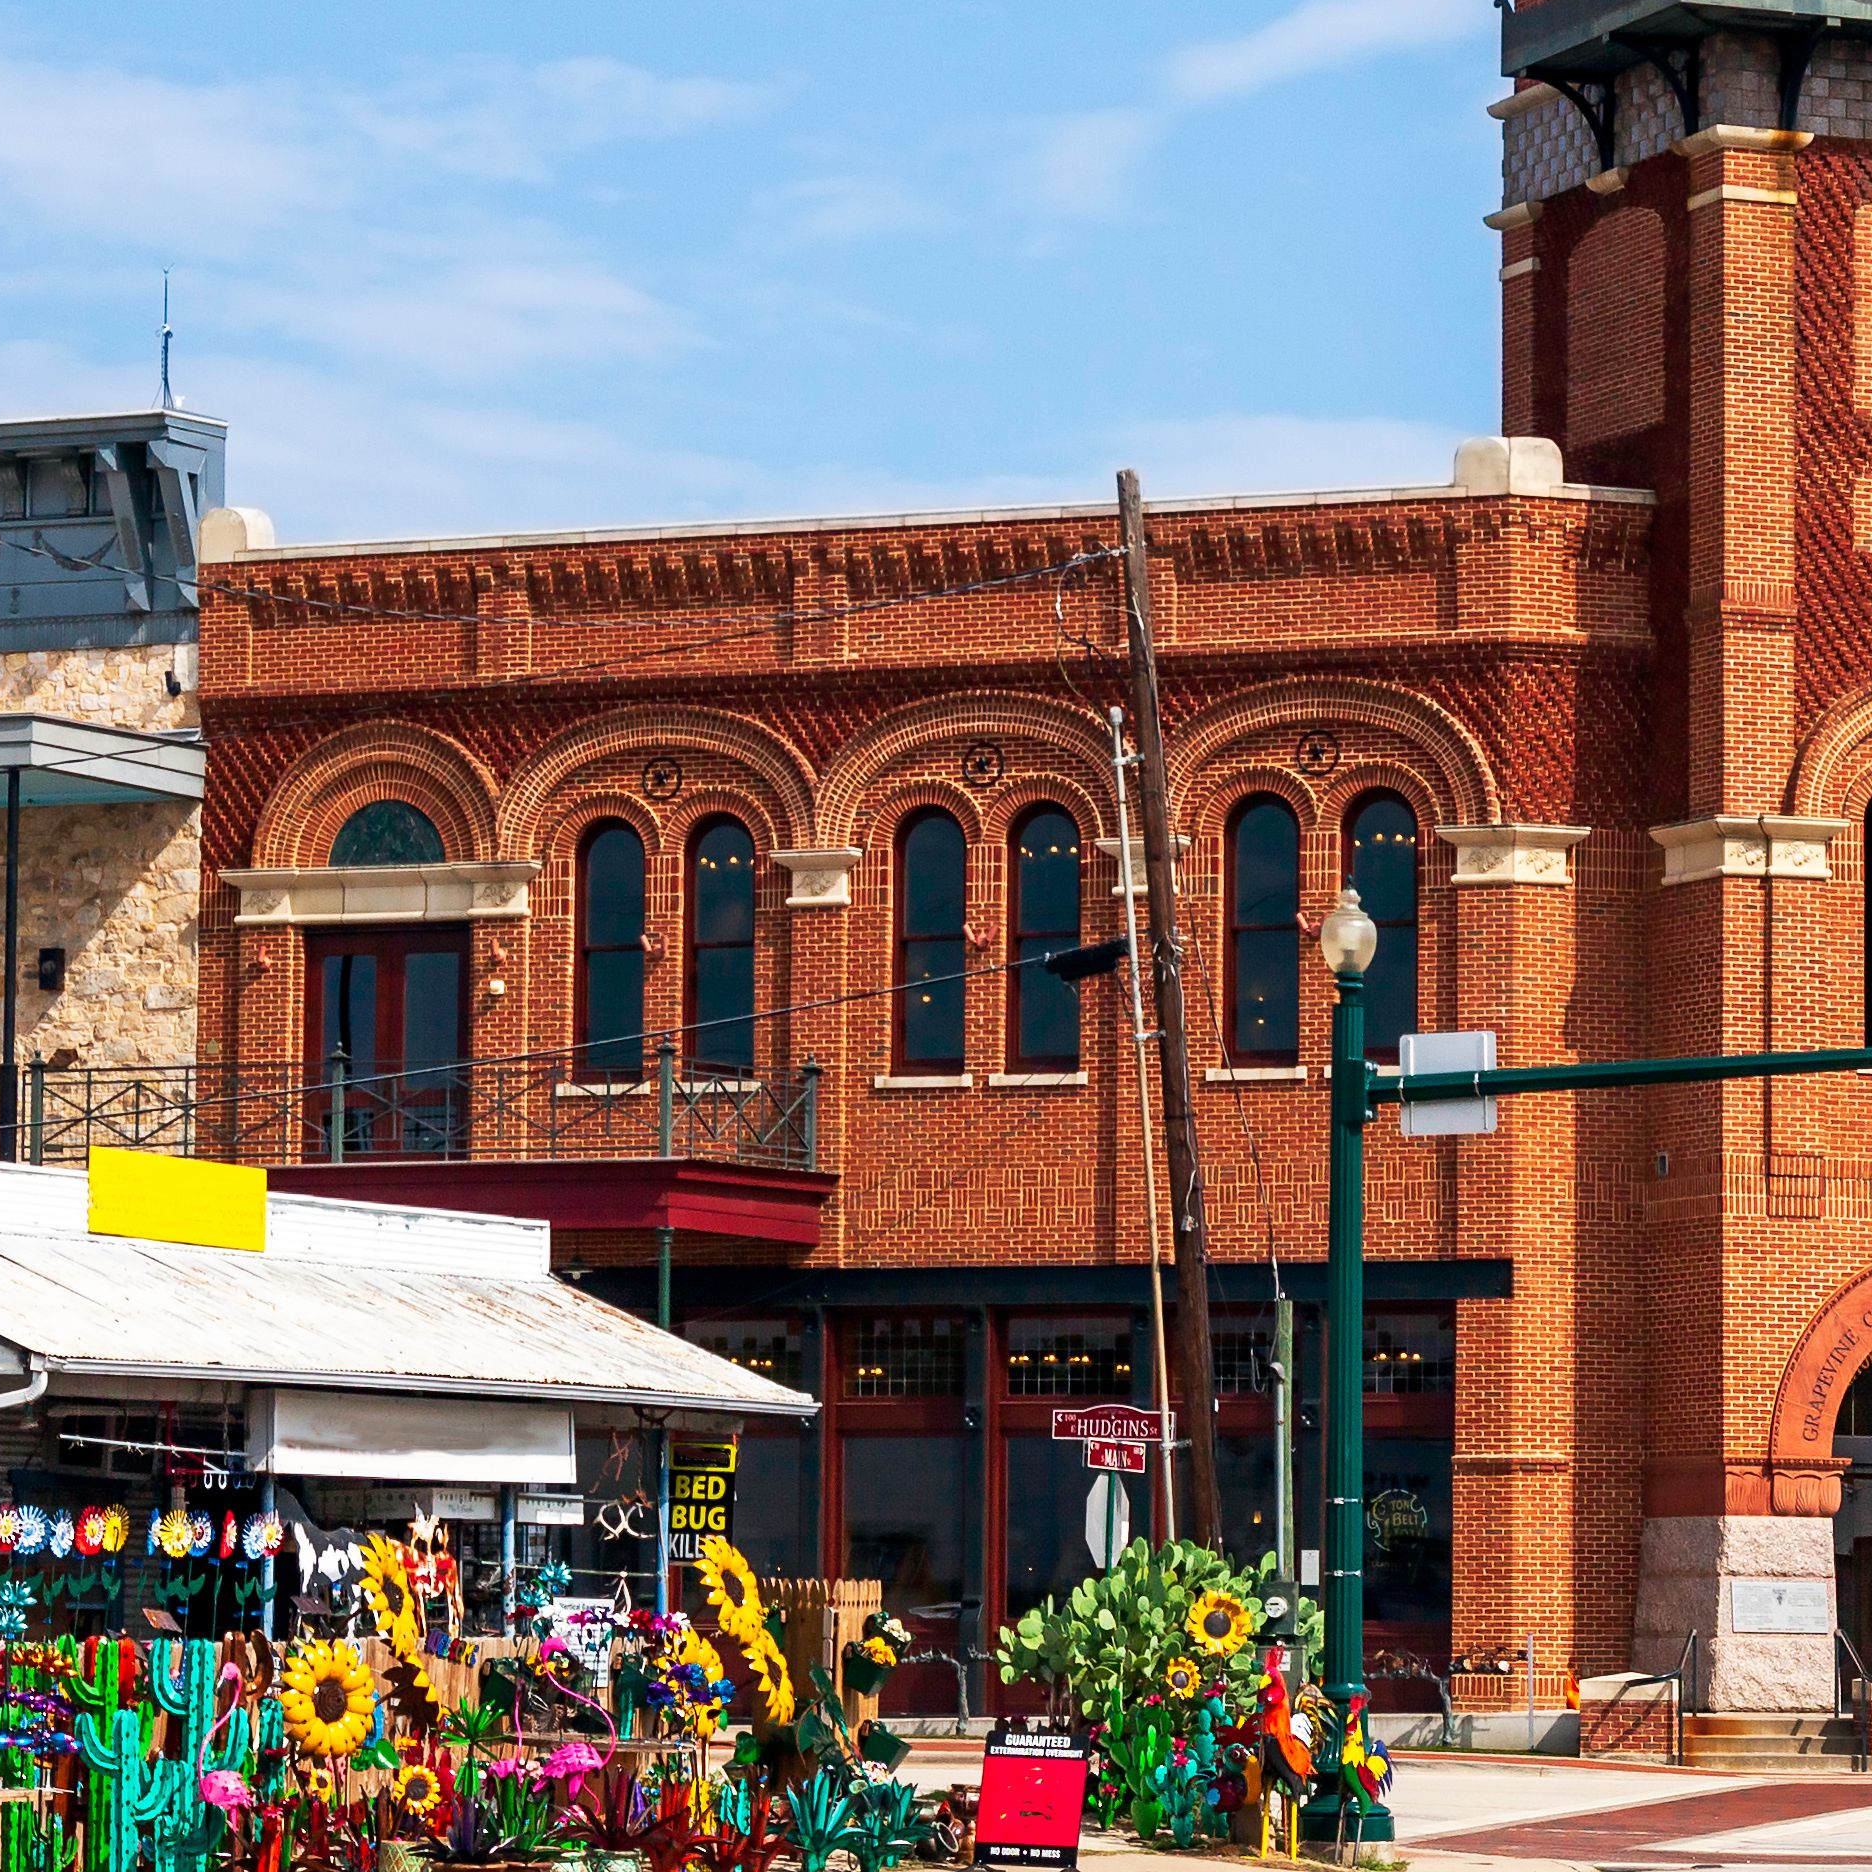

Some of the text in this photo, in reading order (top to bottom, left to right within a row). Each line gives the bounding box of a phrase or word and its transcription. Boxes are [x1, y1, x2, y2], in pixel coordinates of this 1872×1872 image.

[1802, 1329, 1860, 1442] GRAPEVINE
[1065, 1414, 1077, 1422] 100
[1078, 1419, 1149, 1437] HUDGINS
[1104, 1448, 1128, 1468] MAIN
[675, 1475, 726, 1500] BED
[671, 1505, 726, 1531] BUG
[1392, 1513, 1418, 1526] BELT
[1005, 1734, 1071, 1748] GUARANTEED
[990, 1746, 1084, 1758] EXTERMINATION OVERNIGHT
[1030, 1849, 1040, 1857] NO
[1042, 1850, 1061, 1858] MESS
